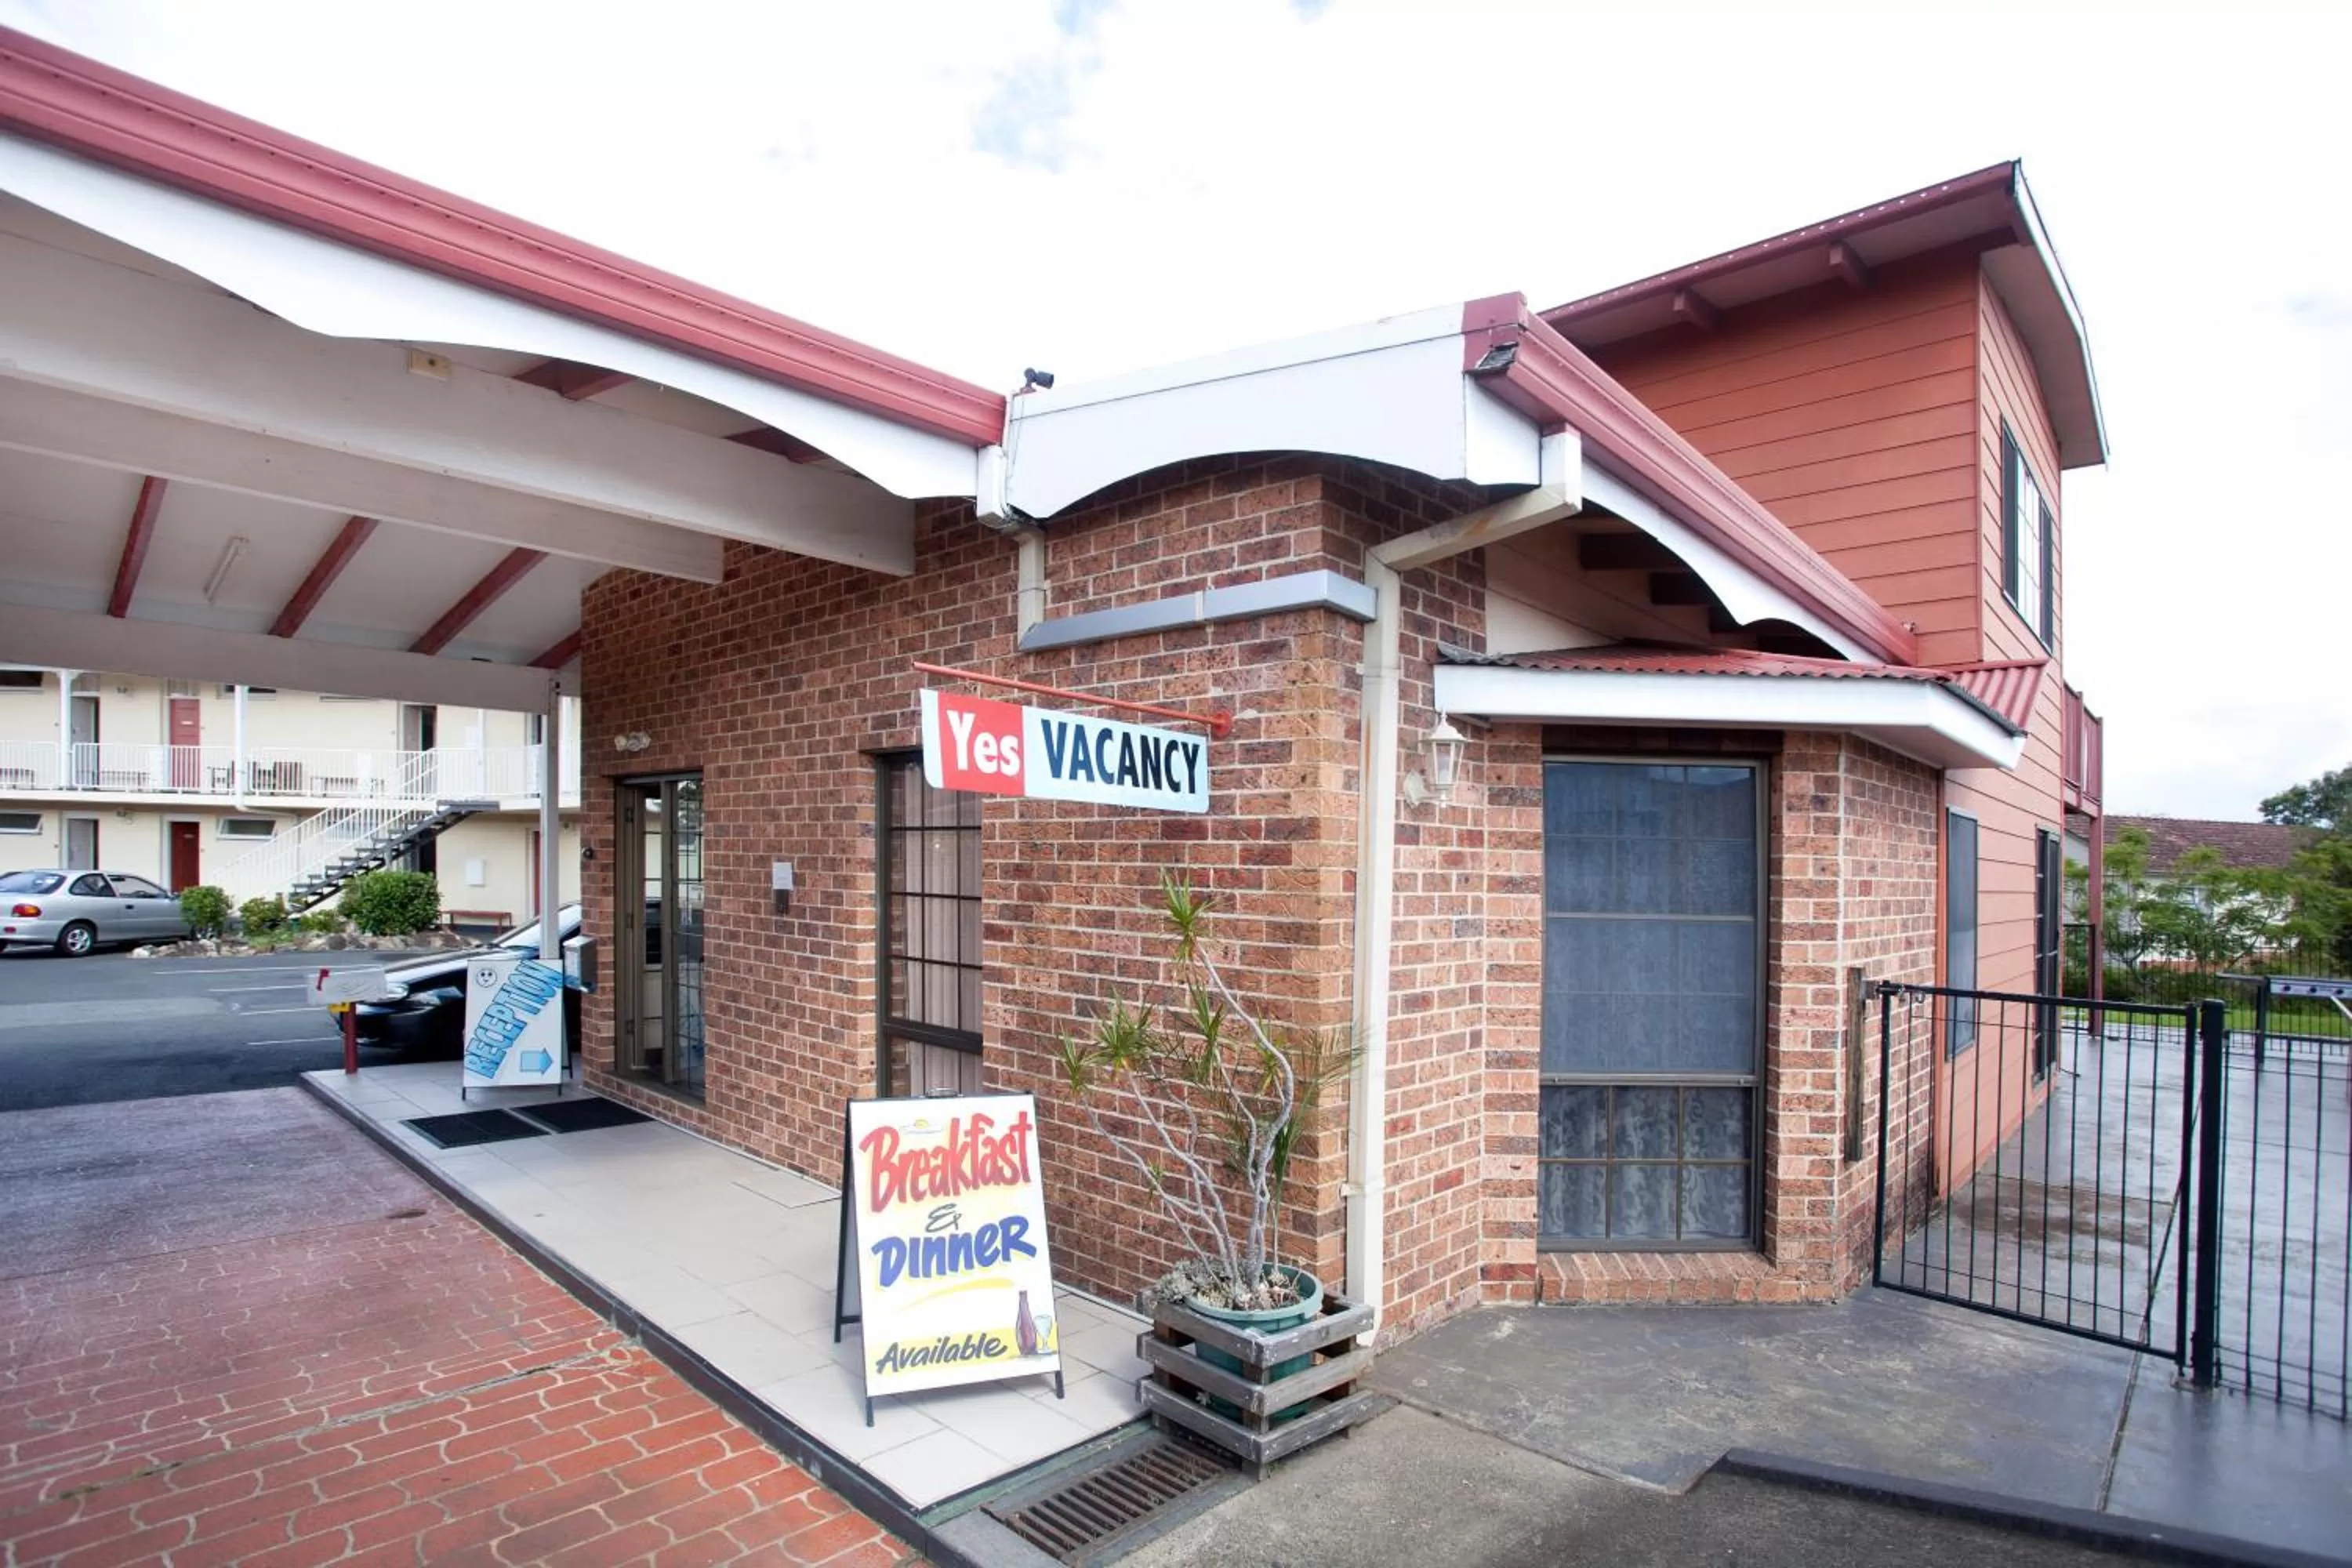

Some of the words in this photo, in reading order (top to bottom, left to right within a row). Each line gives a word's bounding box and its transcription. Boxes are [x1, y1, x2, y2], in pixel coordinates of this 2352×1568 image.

[947, 710, 1020, 775] Yes
[1041, 718, 1200, 794] VACANCY
[465, 959, 563, 1079] RECEPTION
[858, 1111, 1033, 1213] Breakfast
[876, 1332, 1008, 1374] Available
